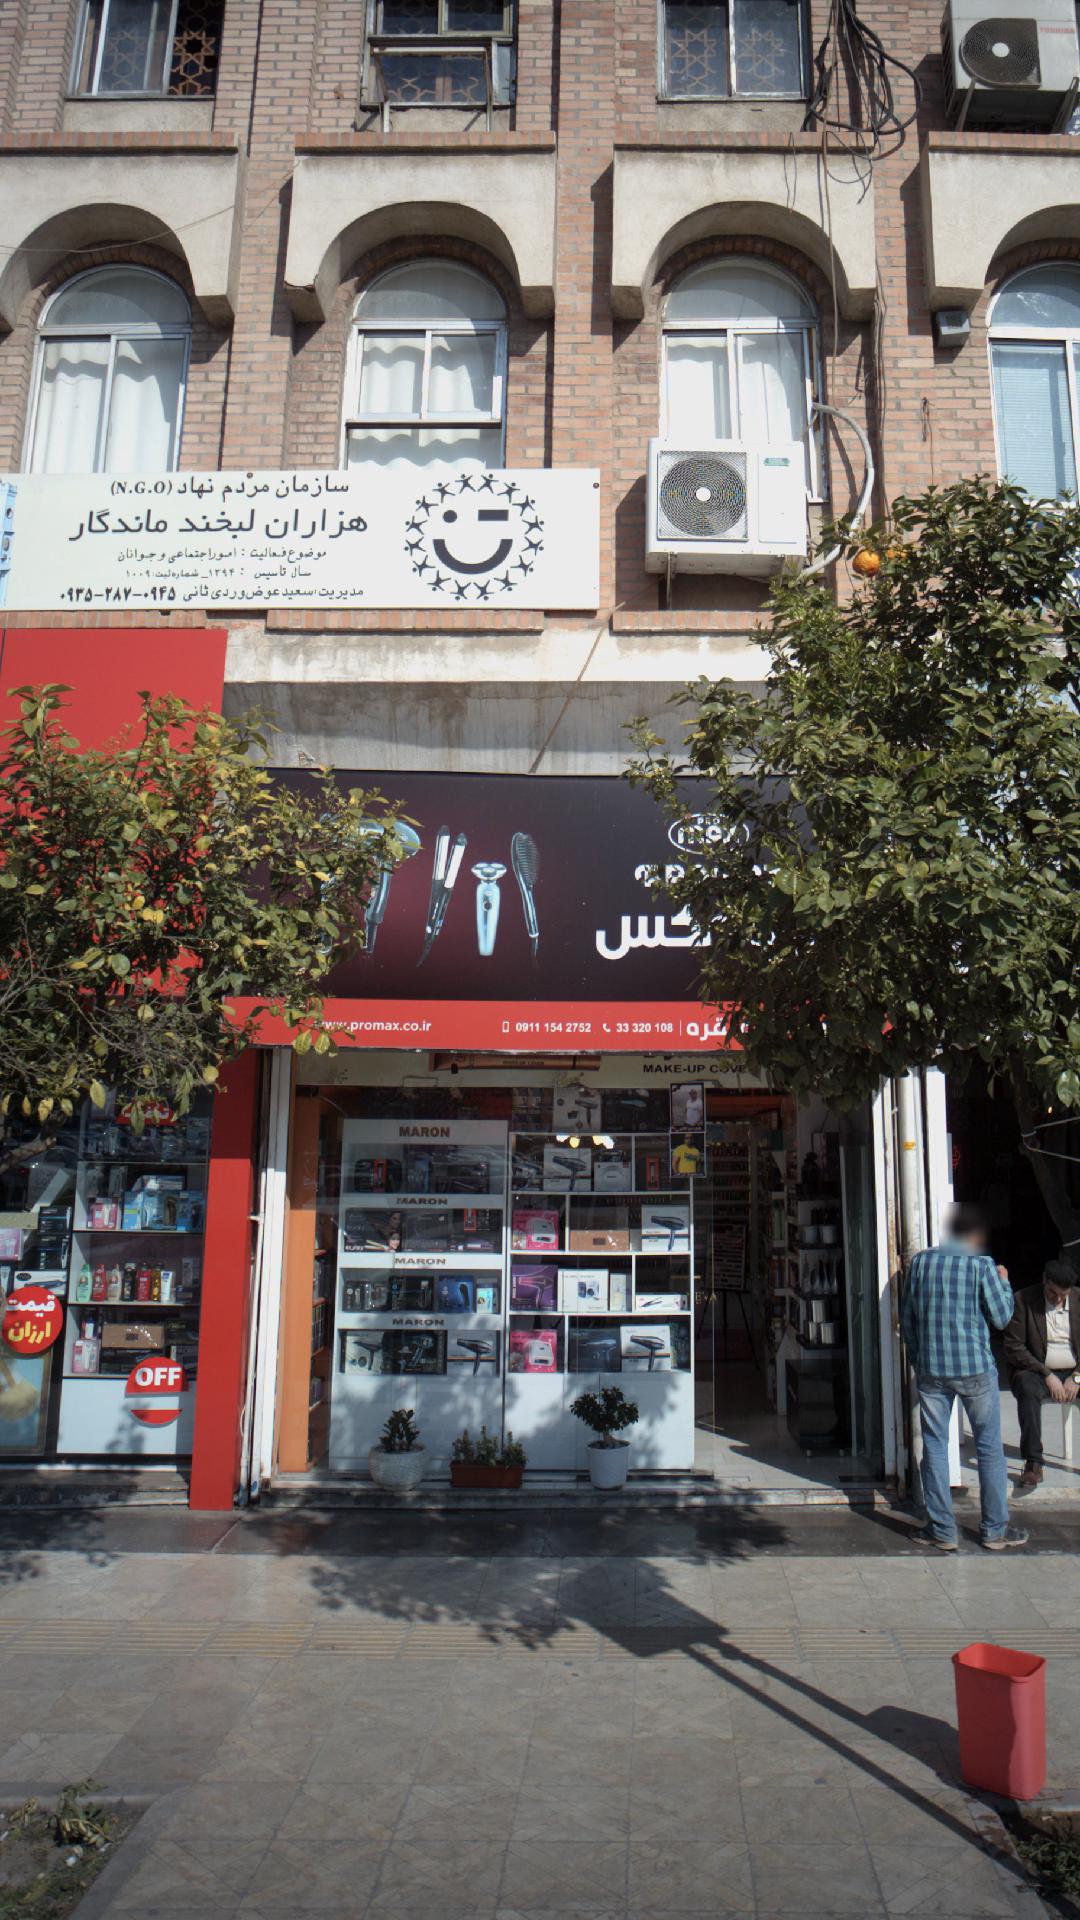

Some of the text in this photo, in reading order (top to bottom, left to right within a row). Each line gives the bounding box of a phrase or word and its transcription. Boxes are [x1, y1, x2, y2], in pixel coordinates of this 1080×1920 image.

[110, 474, 349, 503] سازمان مردم نهاد (N.G.O)
[68, 508, 368, 541] هزاران لبخند ماندگار
[117, 547, 157, 562] جوانان
[250, 546, 286, 561] فعالیت
[287, 547, 327, 564] موضوع
[291, 565, 312, 579] سال
[515, 1022, 592, 1033] 0911 154 2752
[616, 1023, 673, 1033] 33 320 108
[643, 1064, 706, 1073] MAKE-UP
[399, 1126, 450, 1138] MARON
[396, 1197, 448, 1205] MARON
[394, 1257, 446, 1265] MARON
[6, 1295, 56, 1318] قیمت
[392, 1318, 445, 1326] MARON
[8, 1321, 52, 1344] ارزان
[135, 1367, 182, 1386] OFF
